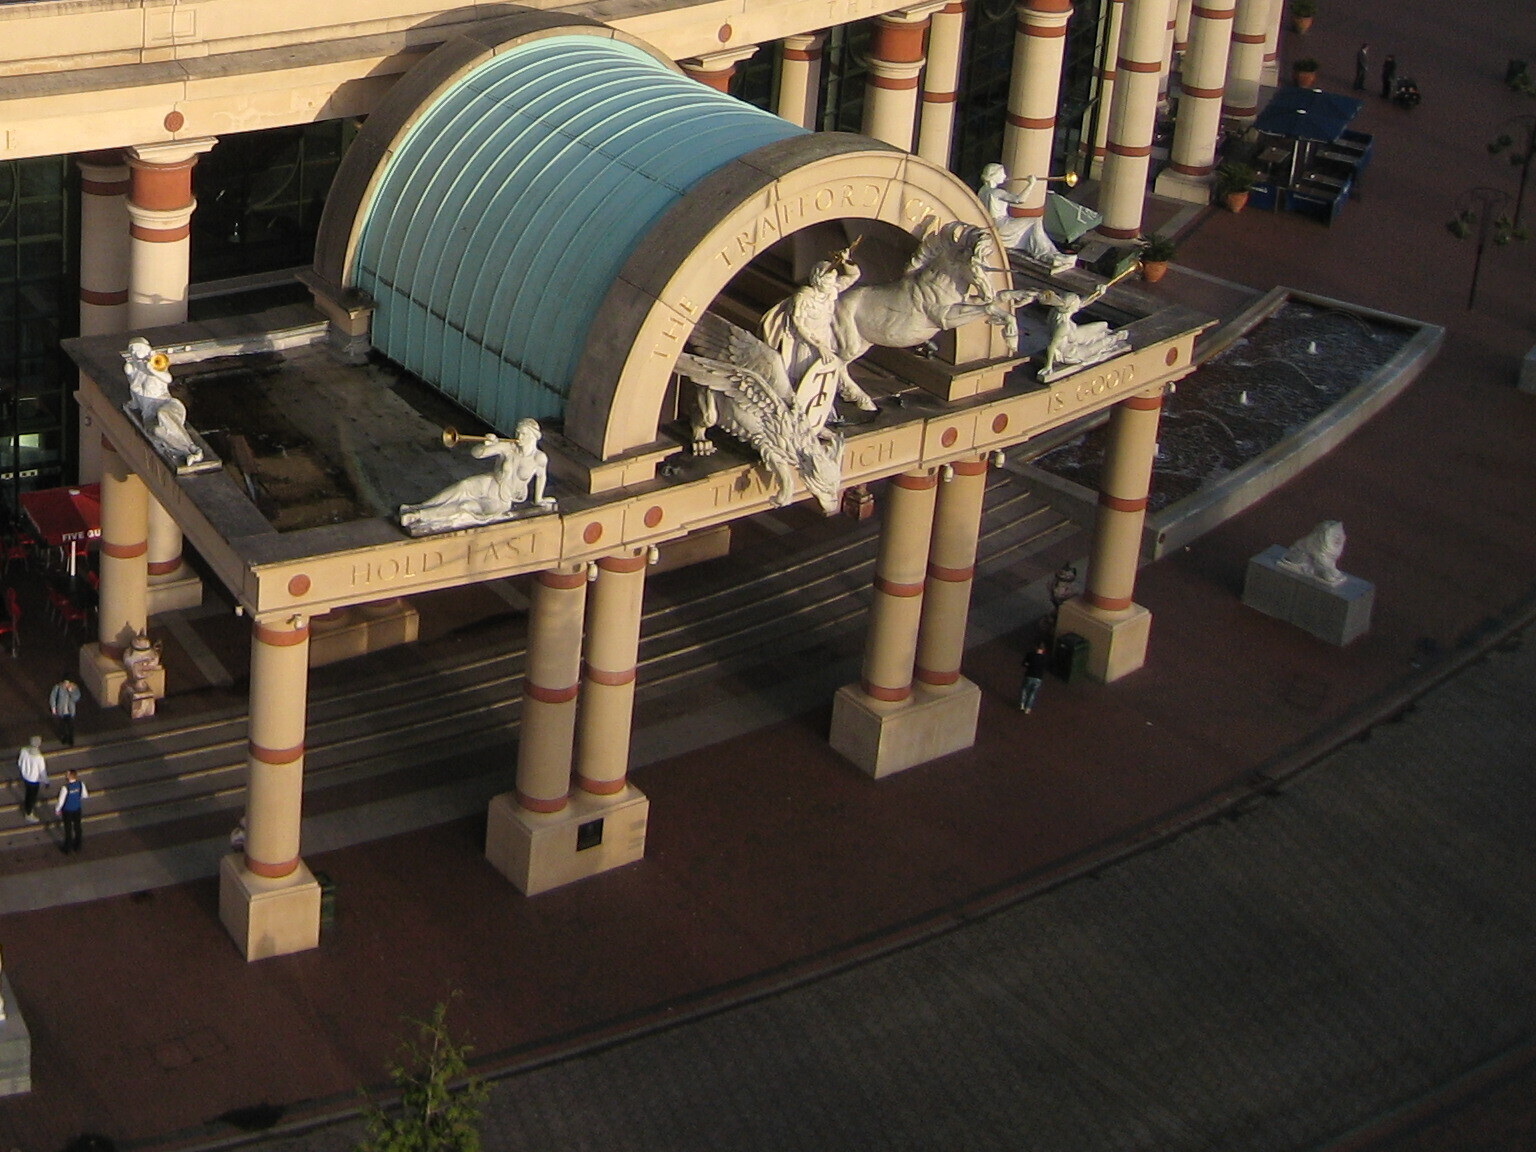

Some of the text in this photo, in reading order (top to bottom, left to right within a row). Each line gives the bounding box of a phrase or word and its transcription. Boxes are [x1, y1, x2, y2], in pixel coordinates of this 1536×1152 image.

[651, 296, 700, 360] THE
[714, 183, 882, 271] TRAFFORD
[1047, 363, 1136, 415] IS GOOD
[61, 528, 102, 542] FIVE GU
[351, 533, 538, 587] HOLD FAST
